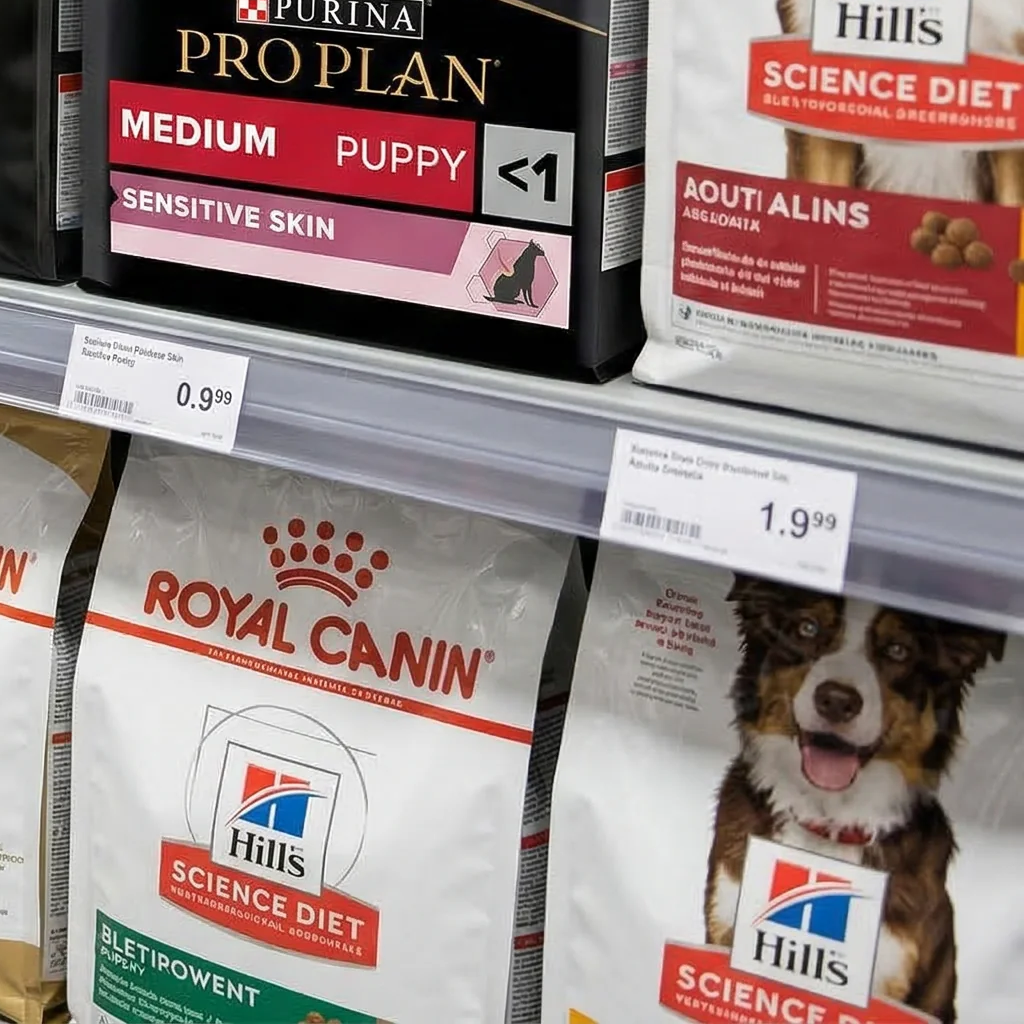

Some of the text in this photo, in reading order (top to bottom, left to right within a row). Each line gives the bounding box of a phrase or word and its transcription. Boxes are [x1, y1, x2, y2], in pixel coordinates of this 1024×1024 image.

[176, 29, 492, 105] PRO PLAN
[763, 60, 1021, 111] SCIENCE DIET
[121, 109, 467, 181] MEDIUM PUPPY
[497, 152, 558, 203] <1
[122, 188, 335, 241] SENSITIVE SKIN
[767, 193, 870, 230] ALINS
[143, 569, 296, 655] ROYAL
[309, 614, 482, 700] CANIN
[228, 826, 305, 879] Hill's
[171, 859, 365, 940] SCIENCE DIET
[752, 929, 849, 987] Hill's
